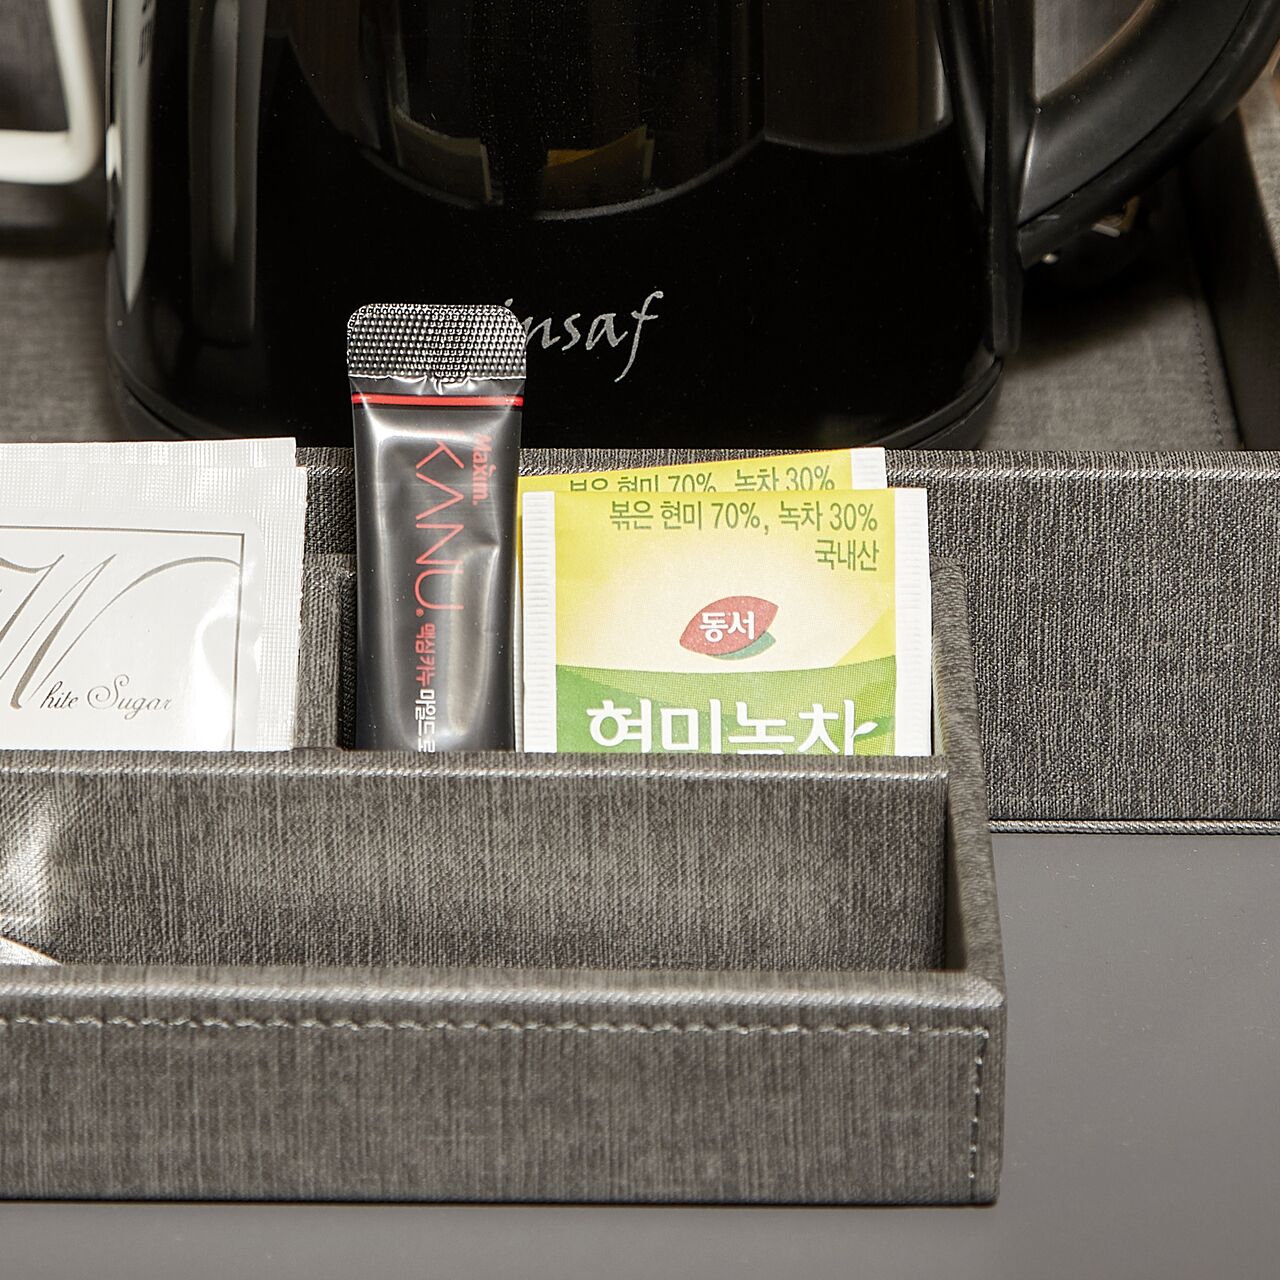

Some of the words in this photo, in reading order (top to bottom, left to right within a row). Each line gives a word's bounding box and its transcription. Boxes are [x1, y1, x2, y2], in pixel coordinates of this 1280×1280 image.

[503, 290, 664, 382] nsaf
[609, 500, 654, 531] 볶은
[660, 500, 703, 530] 현미
[711, 501, 769, 536] 70%,
[778, 500, 823, 531] 녹차
[830, 503, 878, 532] 30%
[815, 538, 880, 572] 국내산
[699, 610, 756, 643] 동서
[86, 673, 174, 721] Sugar
